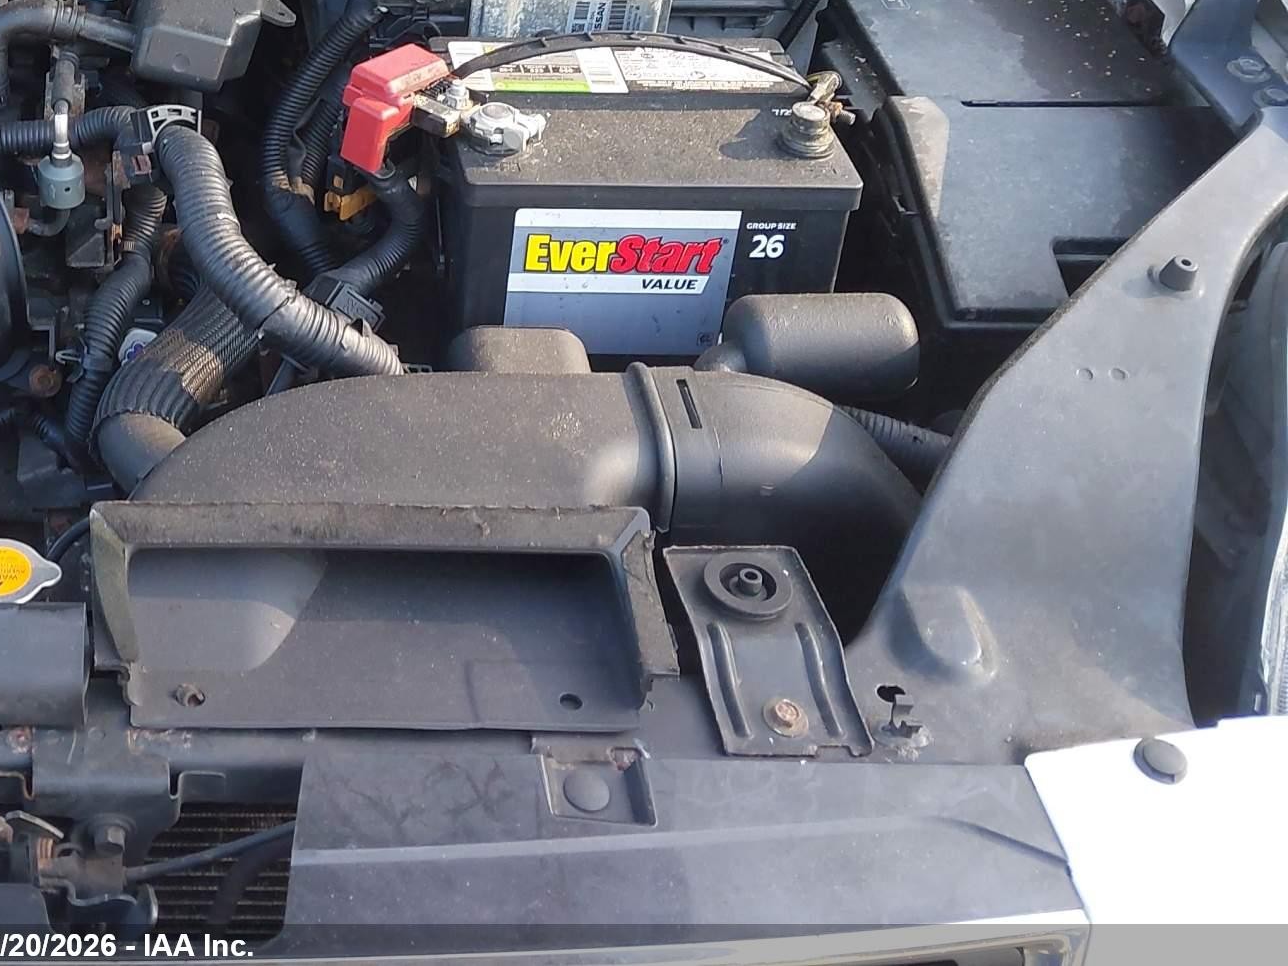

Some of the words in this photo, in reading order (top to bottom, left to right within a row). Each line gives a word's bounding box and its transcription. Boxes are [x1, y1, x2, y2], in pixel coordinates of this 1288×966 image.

[746, 222, 777, 230] GROUP
[778, 222, 797, 230] SIZE
[523, 233, 724, 275] EverStart
[749, 234, 786, 259] 26
[642, 278, 698, 291] VALUE
